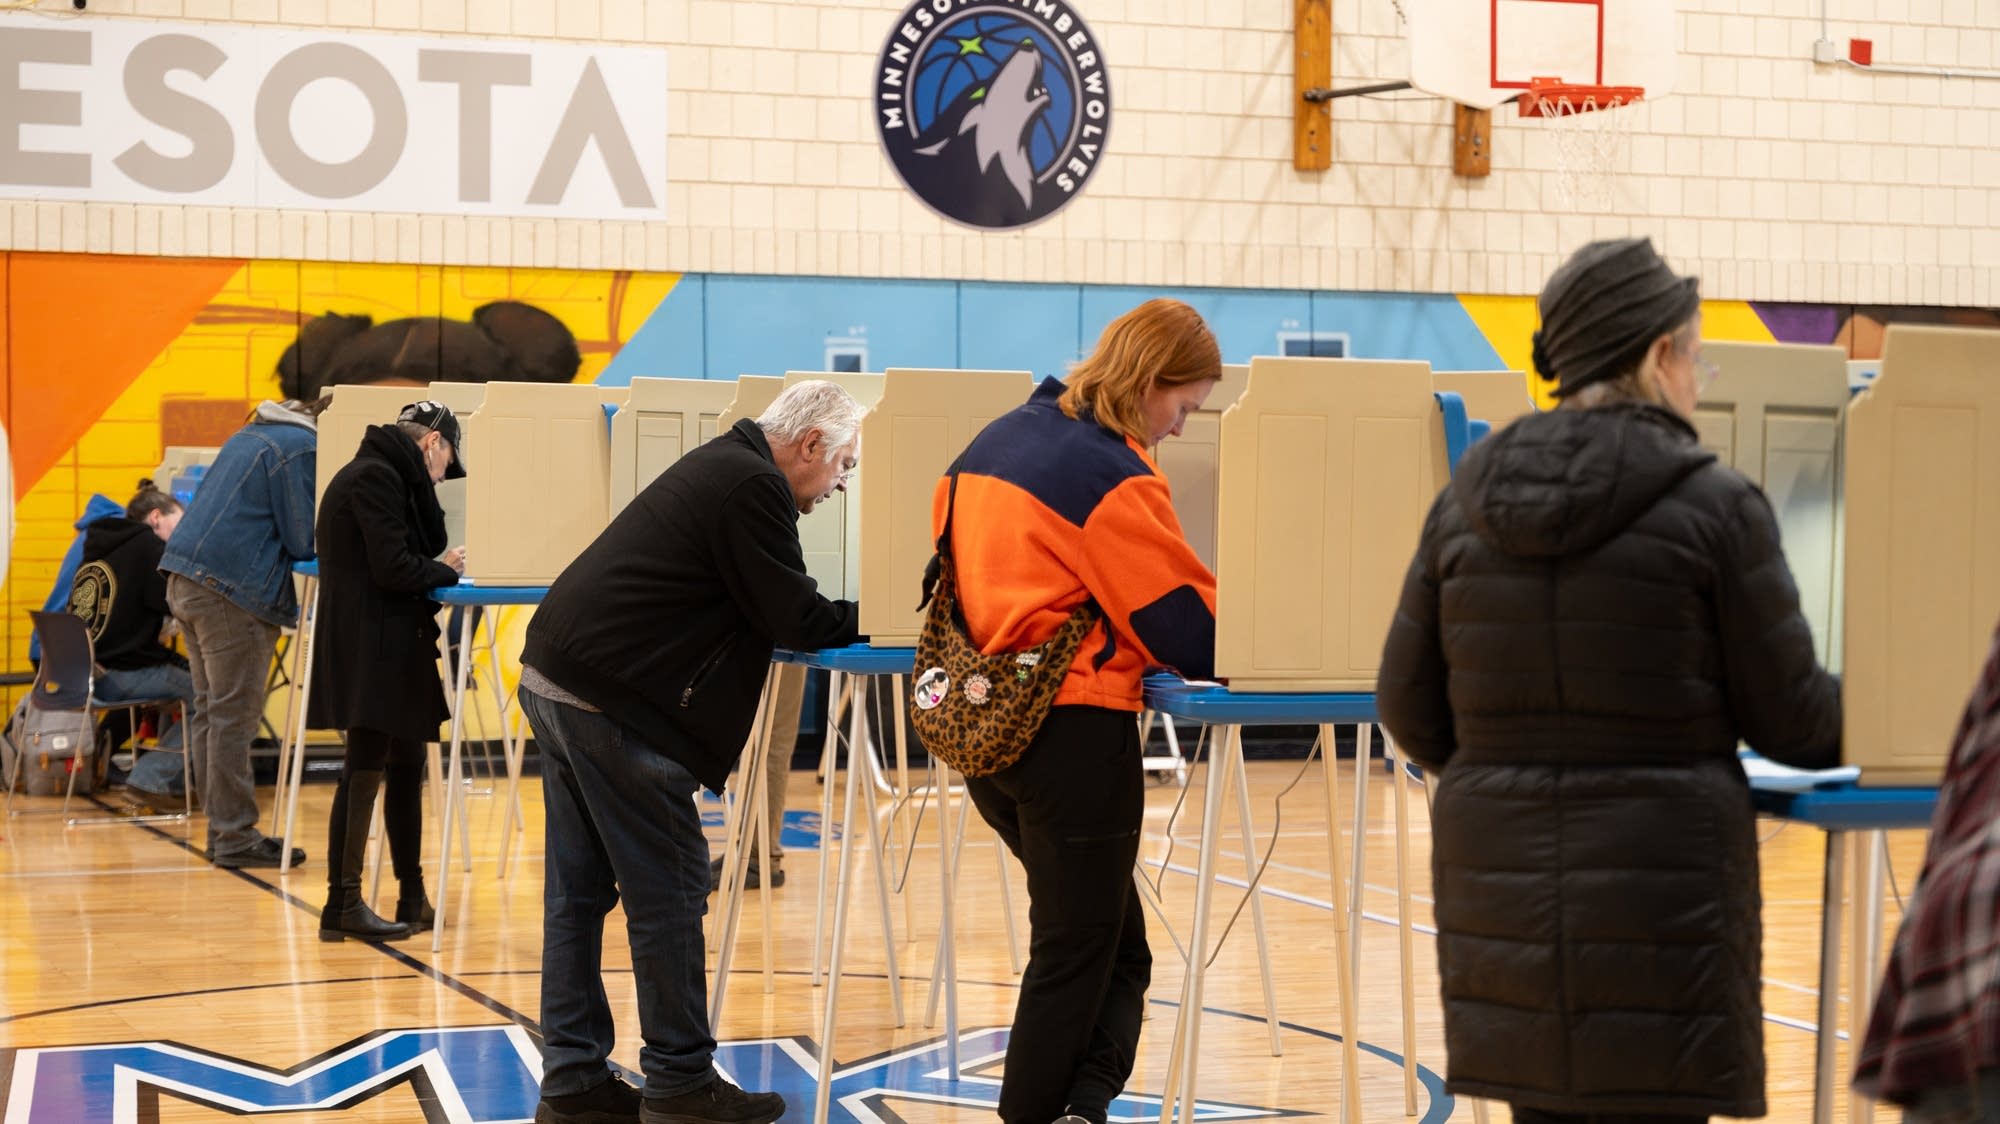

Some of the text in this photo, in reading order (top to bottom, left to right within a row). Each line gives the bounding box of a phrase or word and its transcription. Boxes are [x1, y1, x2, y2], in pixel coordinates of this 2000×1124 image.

[0, 27, 657, 209] ESOTA
[882, 0, 1105, 192] MINNESO MBERWOLVES
